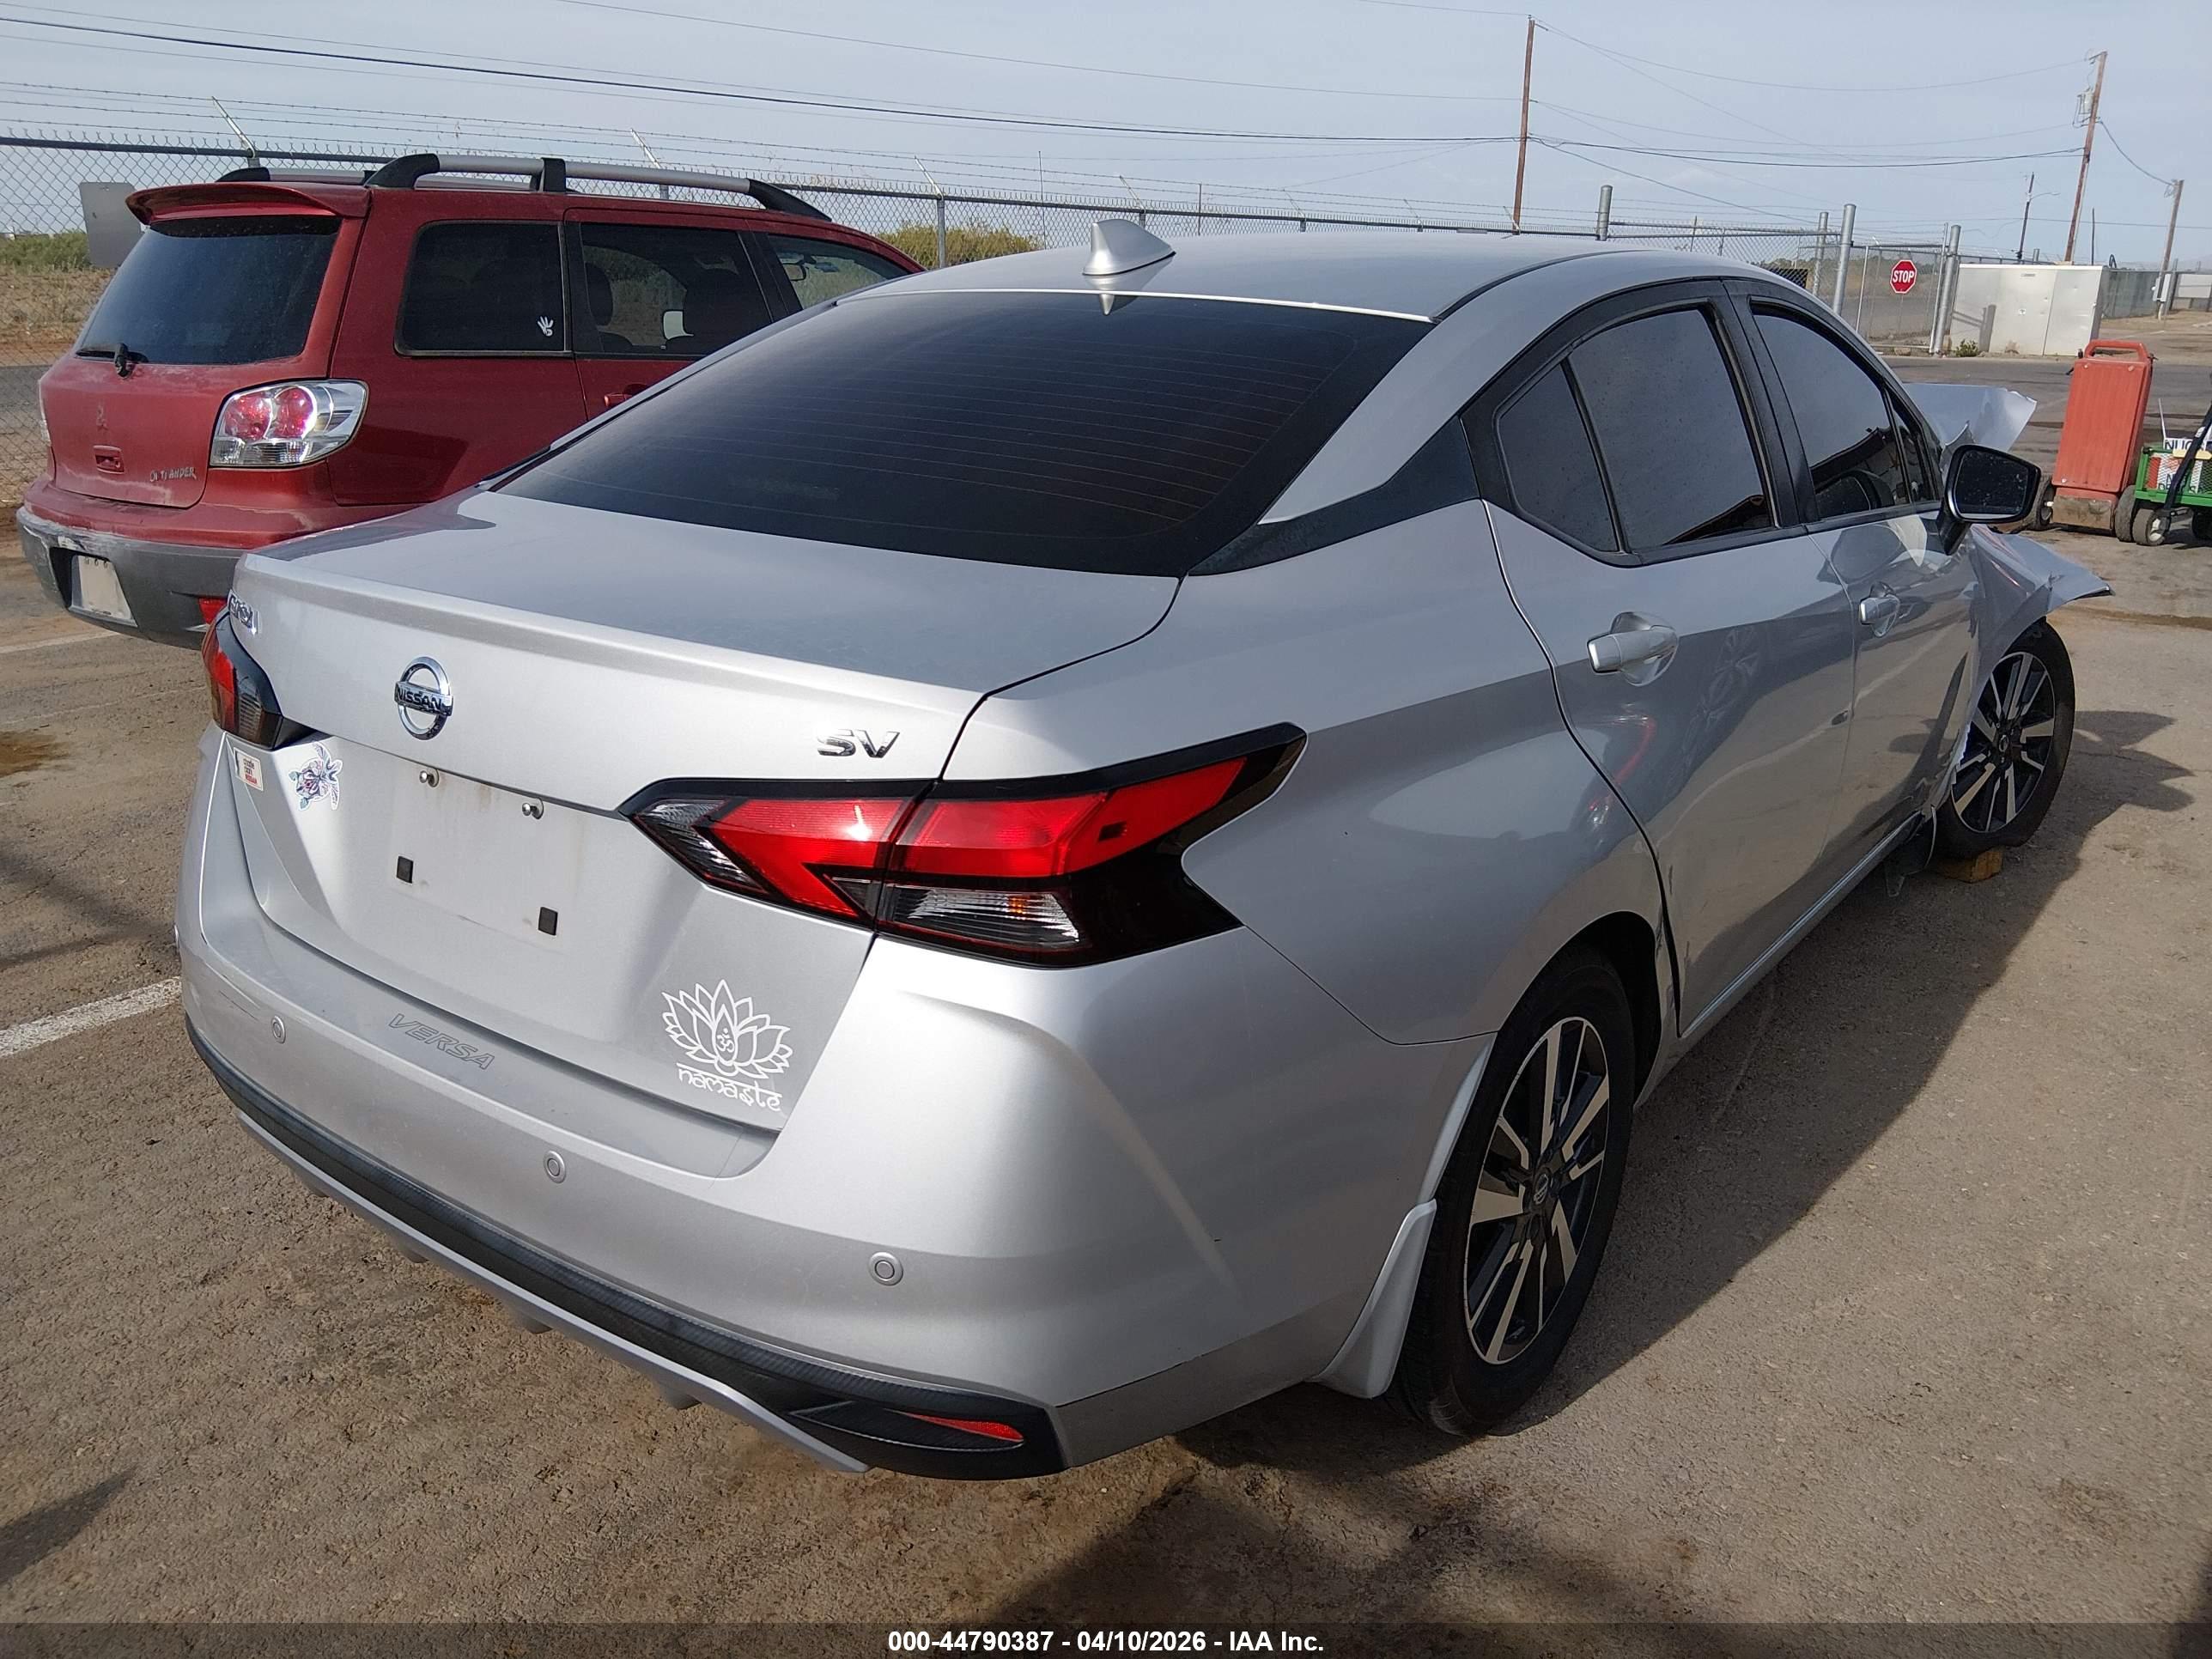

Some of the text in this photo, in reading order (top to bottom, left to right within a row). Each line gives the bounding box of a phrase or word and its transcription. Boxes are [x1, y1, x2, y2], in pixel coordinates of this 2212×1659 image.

[1893, 270, 1915, 283] STOP
[396, 687, 442, 711] NISSAN
[817, 728, 900, 758] SV
[388, 1012, 495, 1070] VERSA
[676, 1062, 783, 1112] namaste
